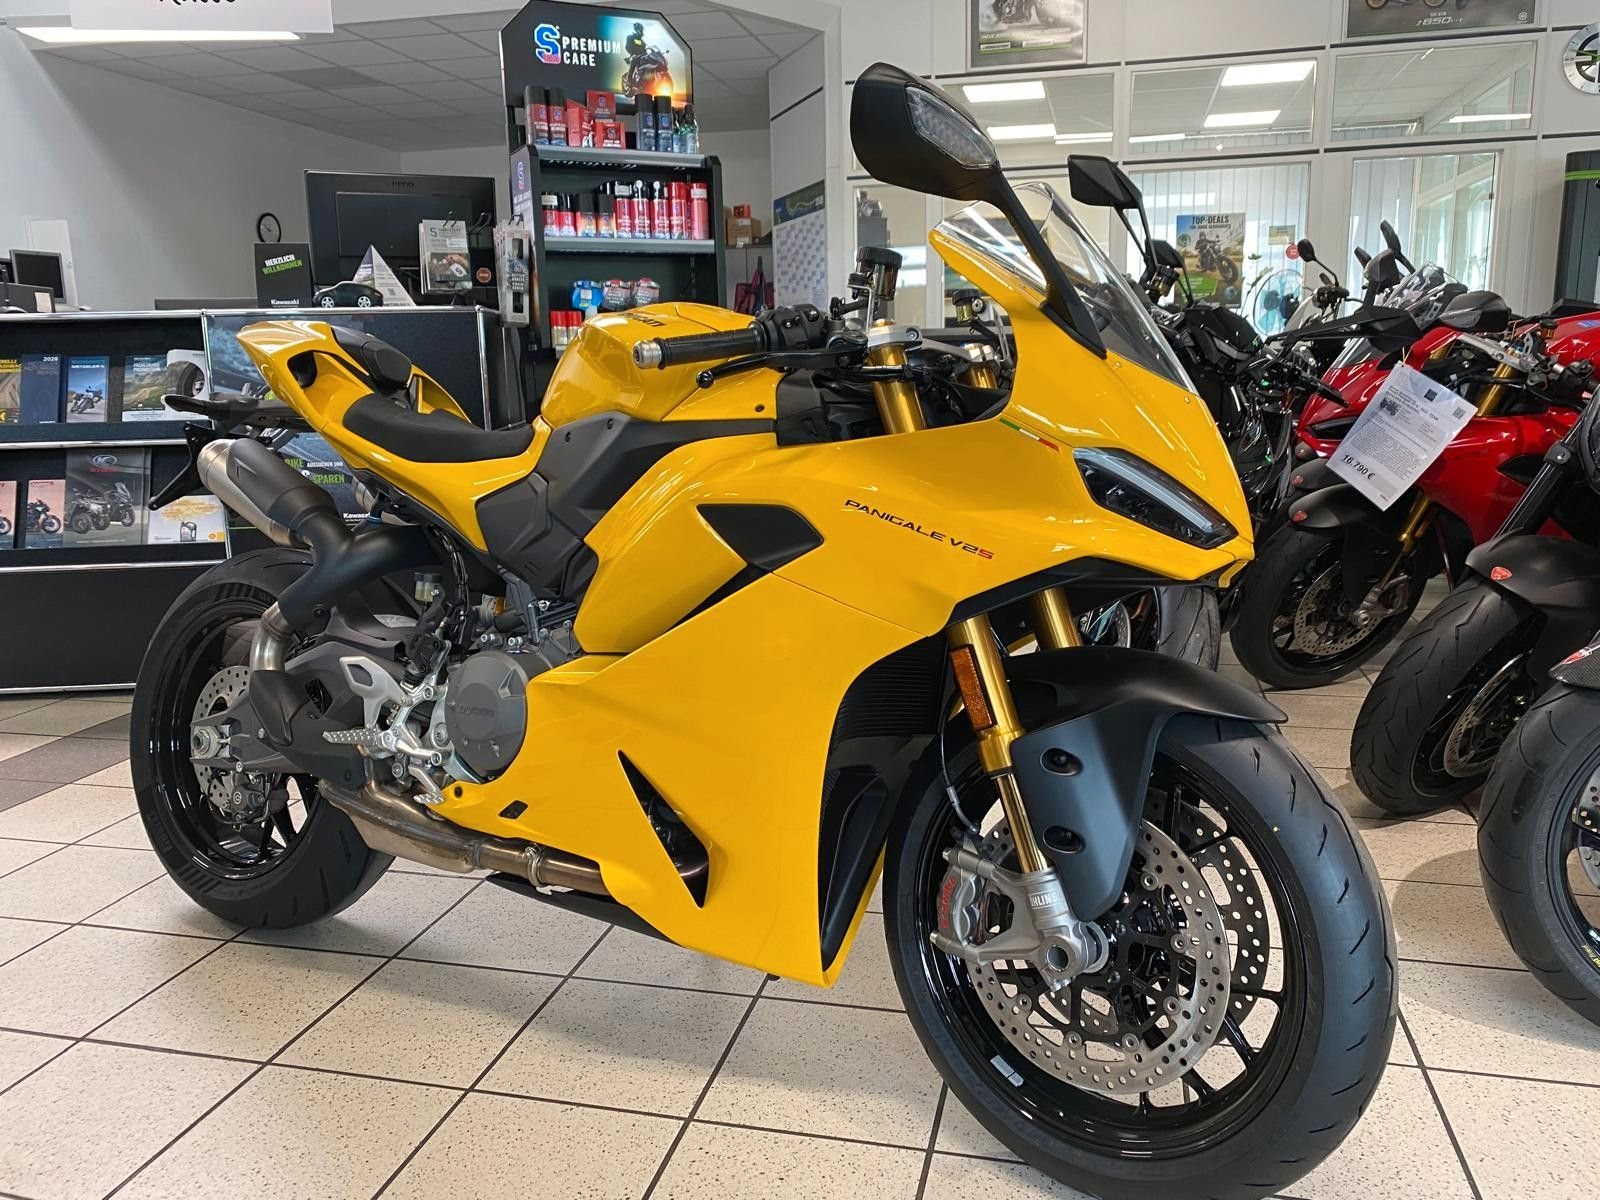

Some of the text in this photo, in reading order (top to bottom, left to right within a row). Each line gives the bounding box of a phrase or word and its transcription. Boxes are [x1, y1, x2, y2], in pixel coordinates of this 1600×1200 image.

[562, 36, 621, 53] PREMIUM
[563, 51, 596, 67] CARE
[1192, 215, 1229, 225] TOP-DEALS
[265, 254, 295, 267] HERZLICH
[1342, 453, 1376, 480] 16.790 €
[313, 474, 345, 484] SPAREN
[949, 537, 994, 560] V2S
